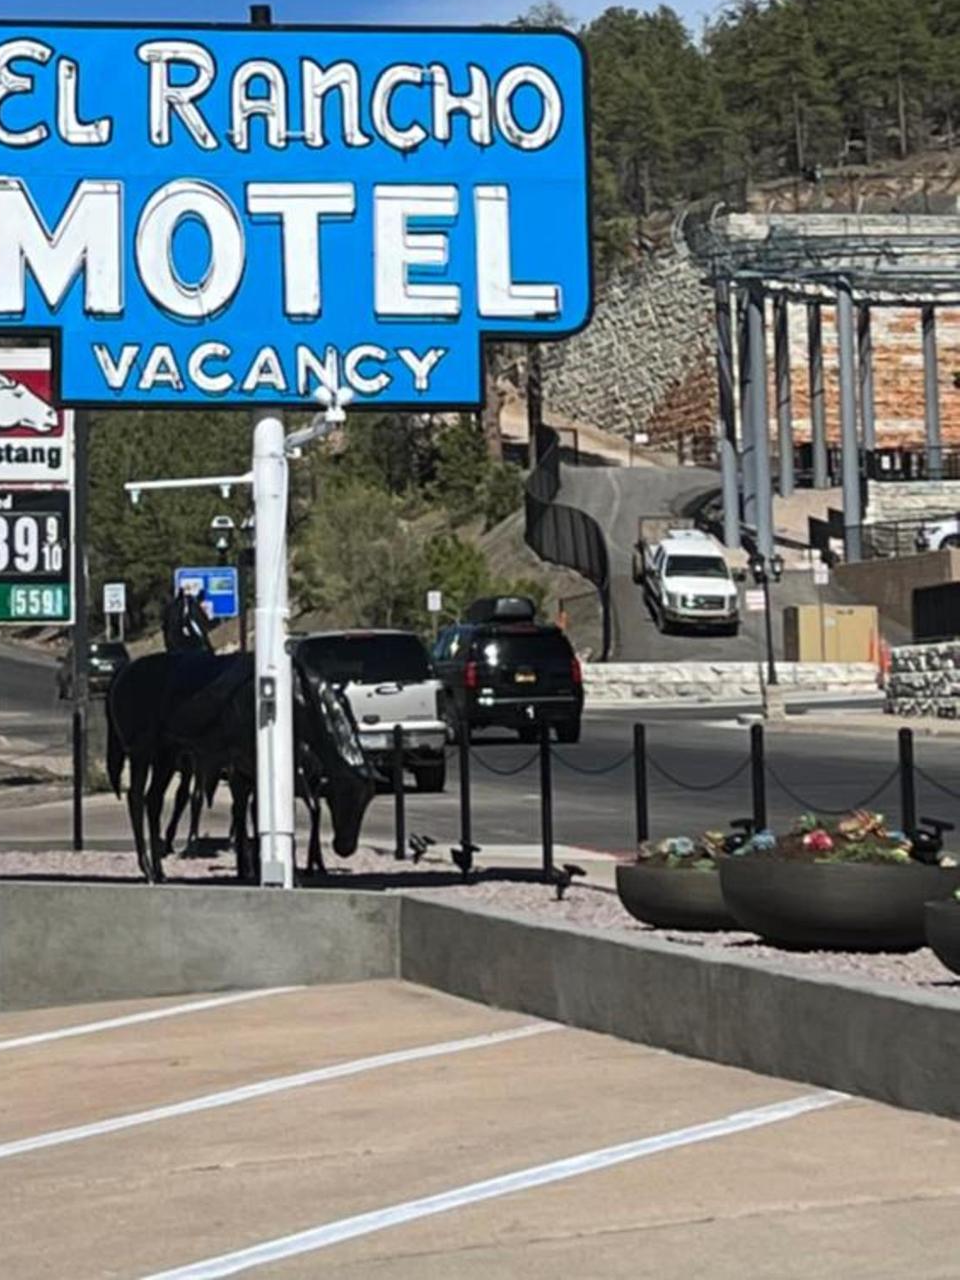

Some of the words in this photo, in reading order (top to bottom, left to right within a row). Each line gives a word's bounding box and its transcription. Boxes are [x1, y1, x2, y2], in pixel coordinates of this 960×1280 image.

[92, 342, 446, 396] VACANCY
[46, 516, 58, 543] 9
[42, 543, 63, 571] 10
